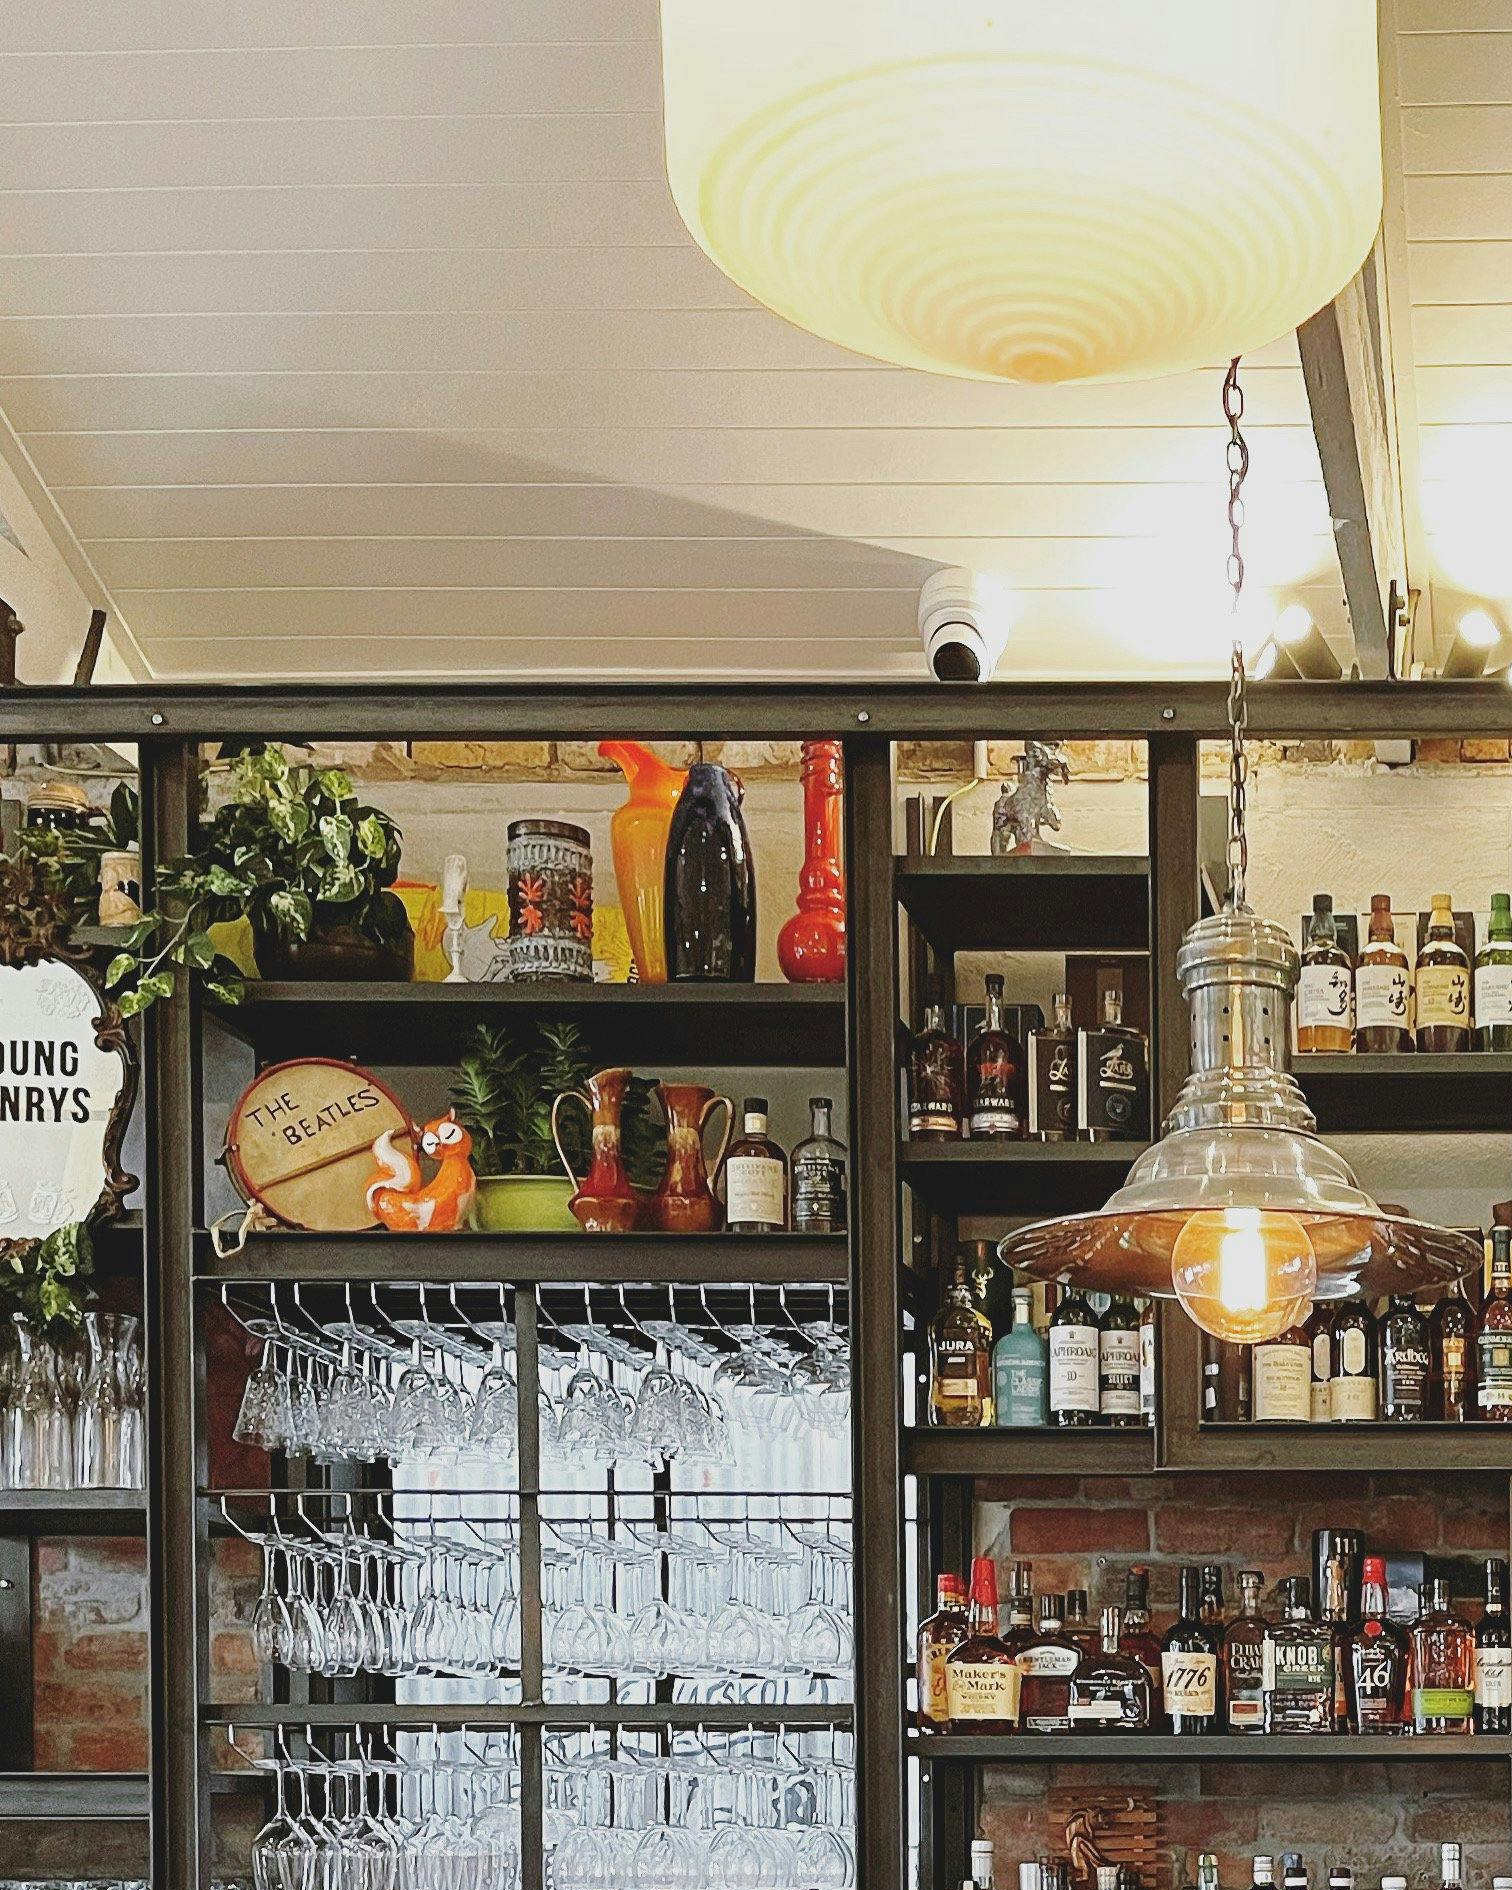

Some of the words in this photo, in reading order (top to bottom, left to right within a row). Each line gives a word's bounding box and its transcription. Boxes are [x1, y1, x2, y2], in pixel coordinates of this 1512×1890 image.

[1327, 970, 1348, 1016] 知多
[1389, 973, 1407, 1016] 山崎
[1449, 974, 1467, 1015] 山崎
[0, 1040, 79, 1076] UNG
[245, 1092, 300, 1128] THE
[282, 1088, 380, 1146] BEATLES
[938, 1339, 975, 1351] JURA
[1066, 1371, 1077, 1381] 10
[1275, 1645, 1318, 1666] KNOB
[1282, 1664, 1326, 1672] CREEK
[952, 1669, 1007, 1679] Maker's
[967, 1681, 1007, 1691] Mark
[1166, 1665, 1211, 1690] 1776
[1357, 1660, 1391, 1695] 46
